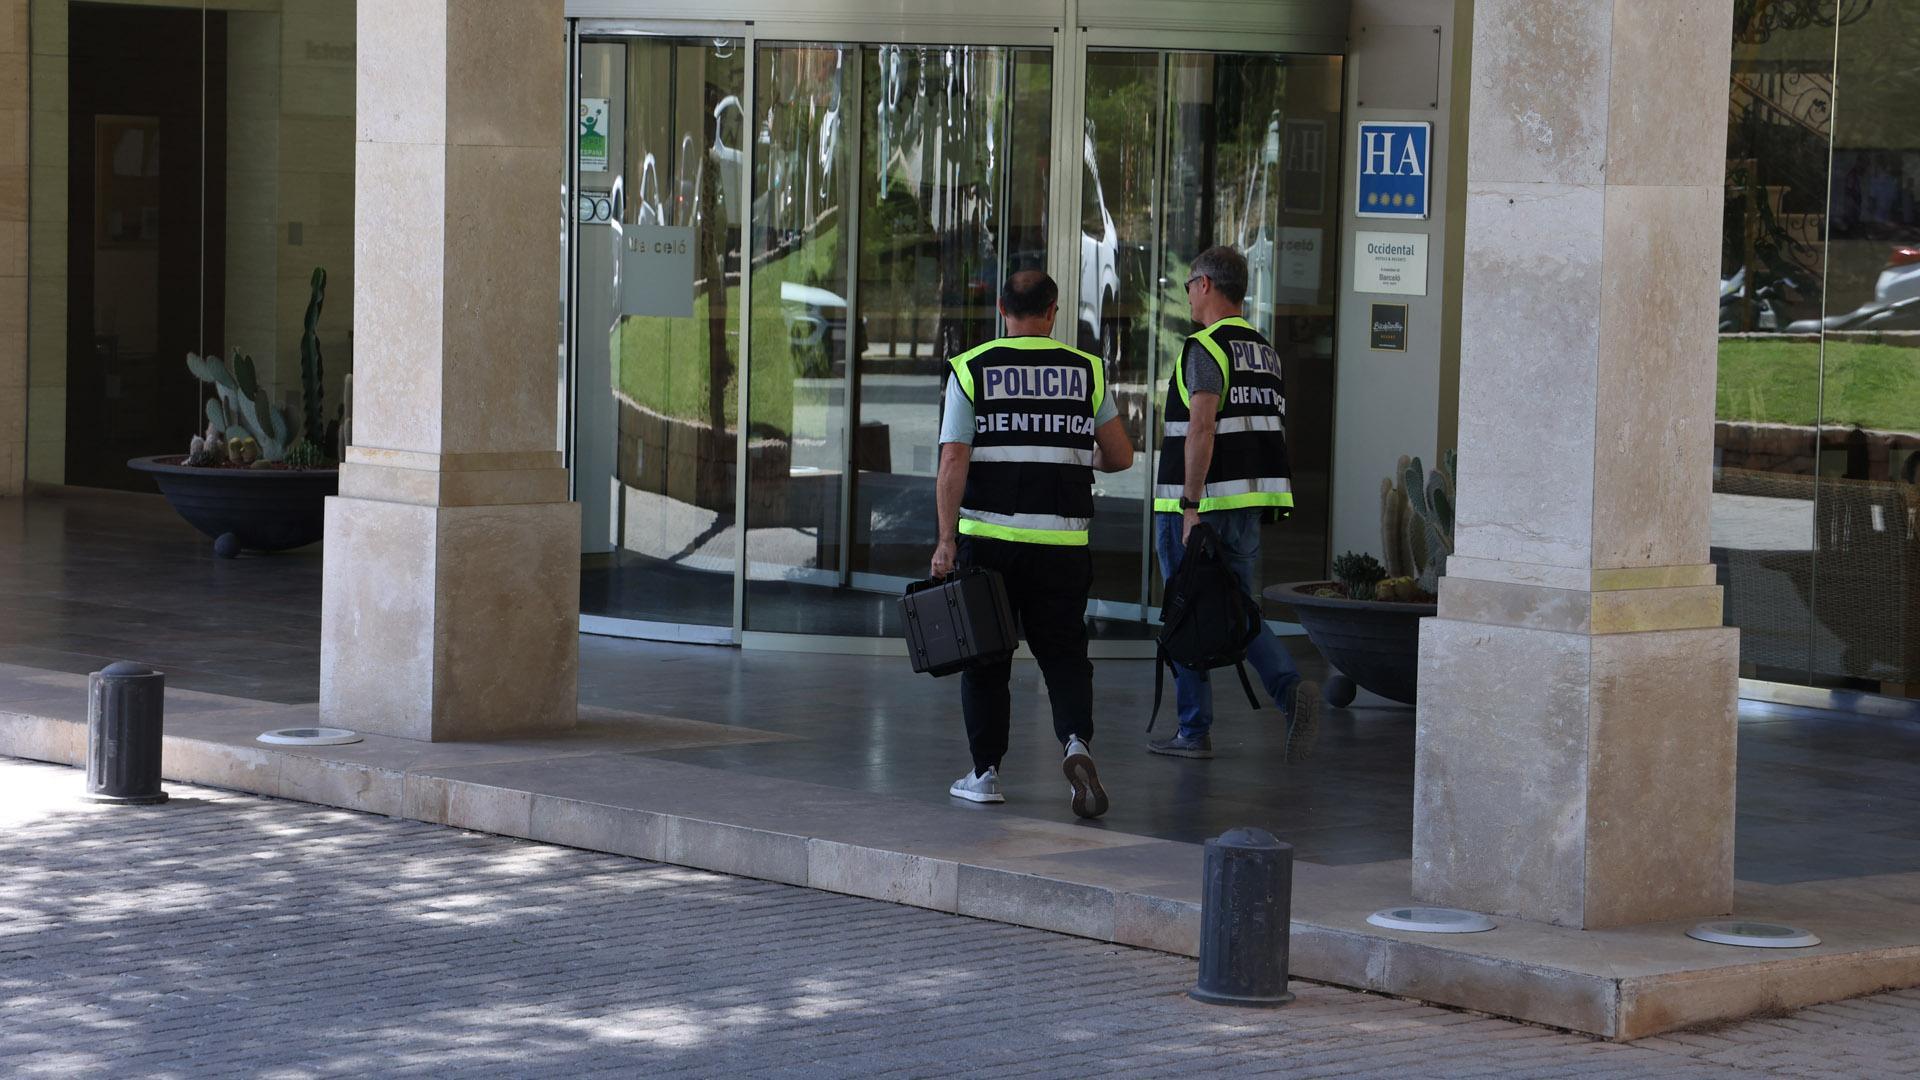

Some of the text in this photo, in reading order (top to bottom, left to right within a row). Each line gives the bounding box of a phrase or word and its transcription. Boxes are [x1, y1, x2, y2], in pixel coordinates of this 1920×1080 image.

[1362, 132, 1424, 176] HA
[1367, 242, 1415, 256] Occidental
[986, 367, 1083, 398] POLICIA
[1230, 386, 1286, 416] CIENTCA
[975, 412, 1095, 436] CIENTIFICA
